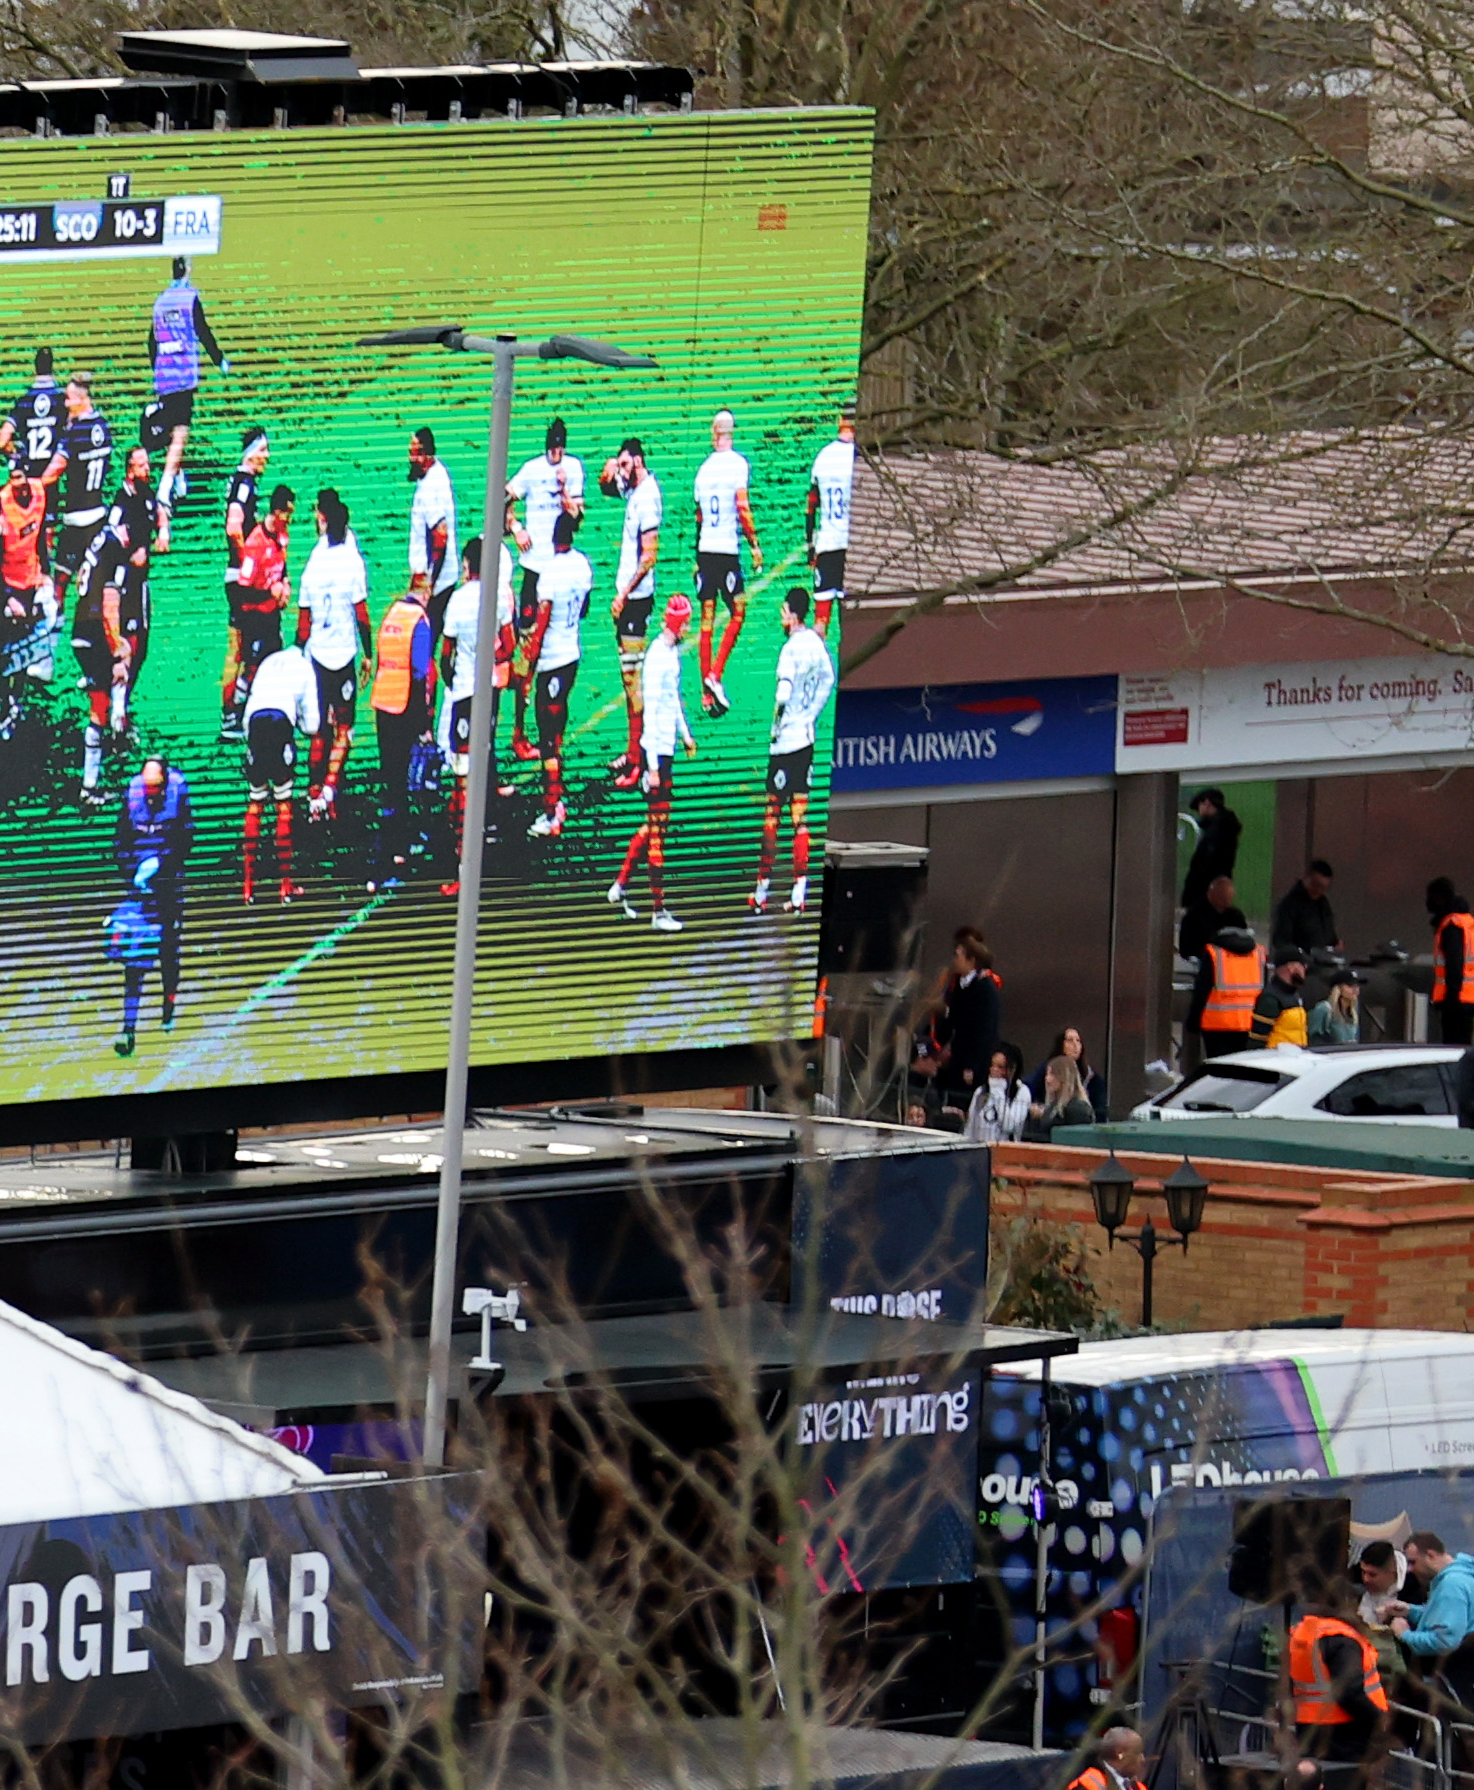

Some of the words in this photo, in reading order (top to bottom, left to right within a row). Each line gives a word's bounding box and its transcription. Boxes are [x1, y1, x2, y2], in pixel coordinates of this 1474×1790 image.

[55, 215, 99, 242] SCO
[113, 208, 158, 239] 10-3
[173, 210, 211, 236] FRA
[1263, 677, 1332, 707] Thanks
[1337, 674, 1365, 703] for
[1369, 673, 1443, 703] coming.
[831, 734, 896, 768] ITISH
[899, 728, 998, 764] AIRWAYS
[181, 1550, 331, 1671] BAR
